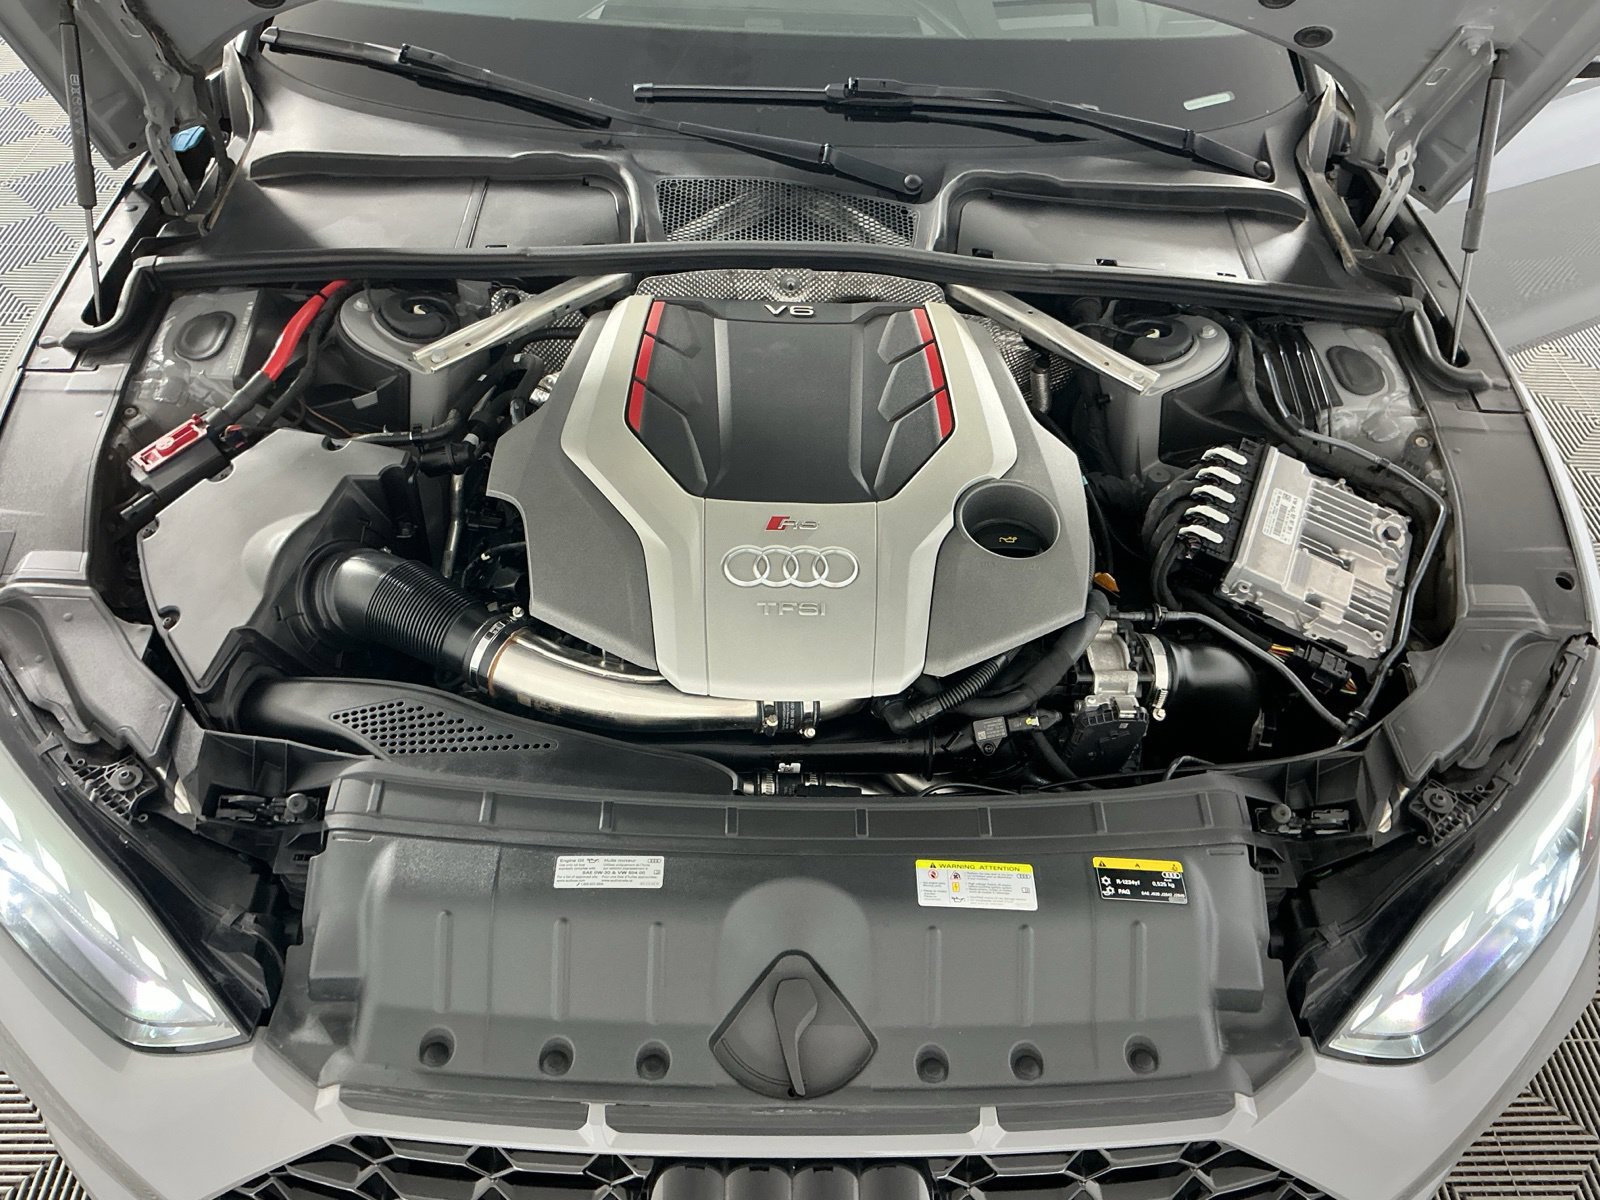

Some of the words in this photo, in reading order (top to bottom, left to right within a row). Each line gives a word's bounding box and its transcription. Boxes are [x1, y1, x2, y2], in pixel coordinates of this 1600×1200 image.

[764, 304, 815, 316] V6
[765, 514, 820, 531] RS
[757, 602, 826, 617] TFSI
